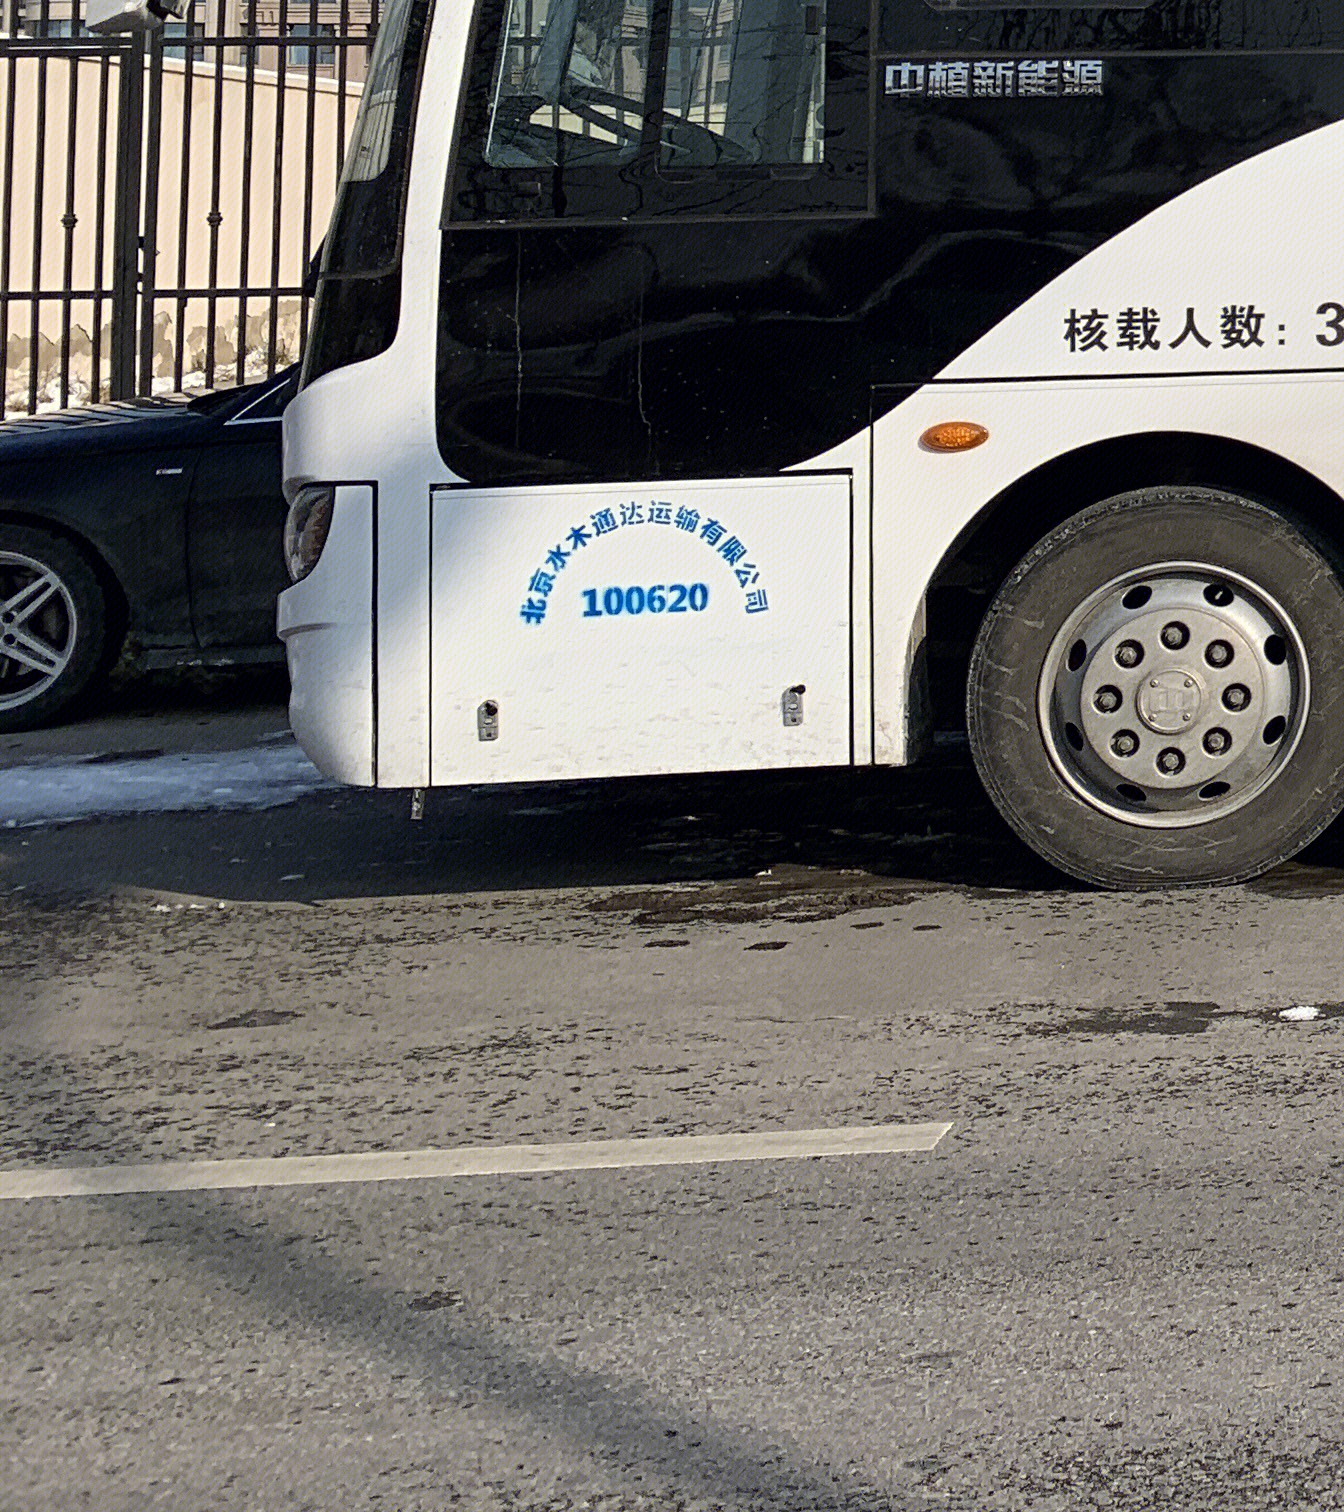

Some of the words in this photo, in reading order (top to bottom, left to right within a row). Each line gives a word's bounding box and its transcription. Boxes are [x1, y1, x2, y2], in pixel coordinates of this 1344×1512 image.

[519, 500, 770, 626] 北京水木通达运输有限公司
[581, 583, 711, 619] 100620
